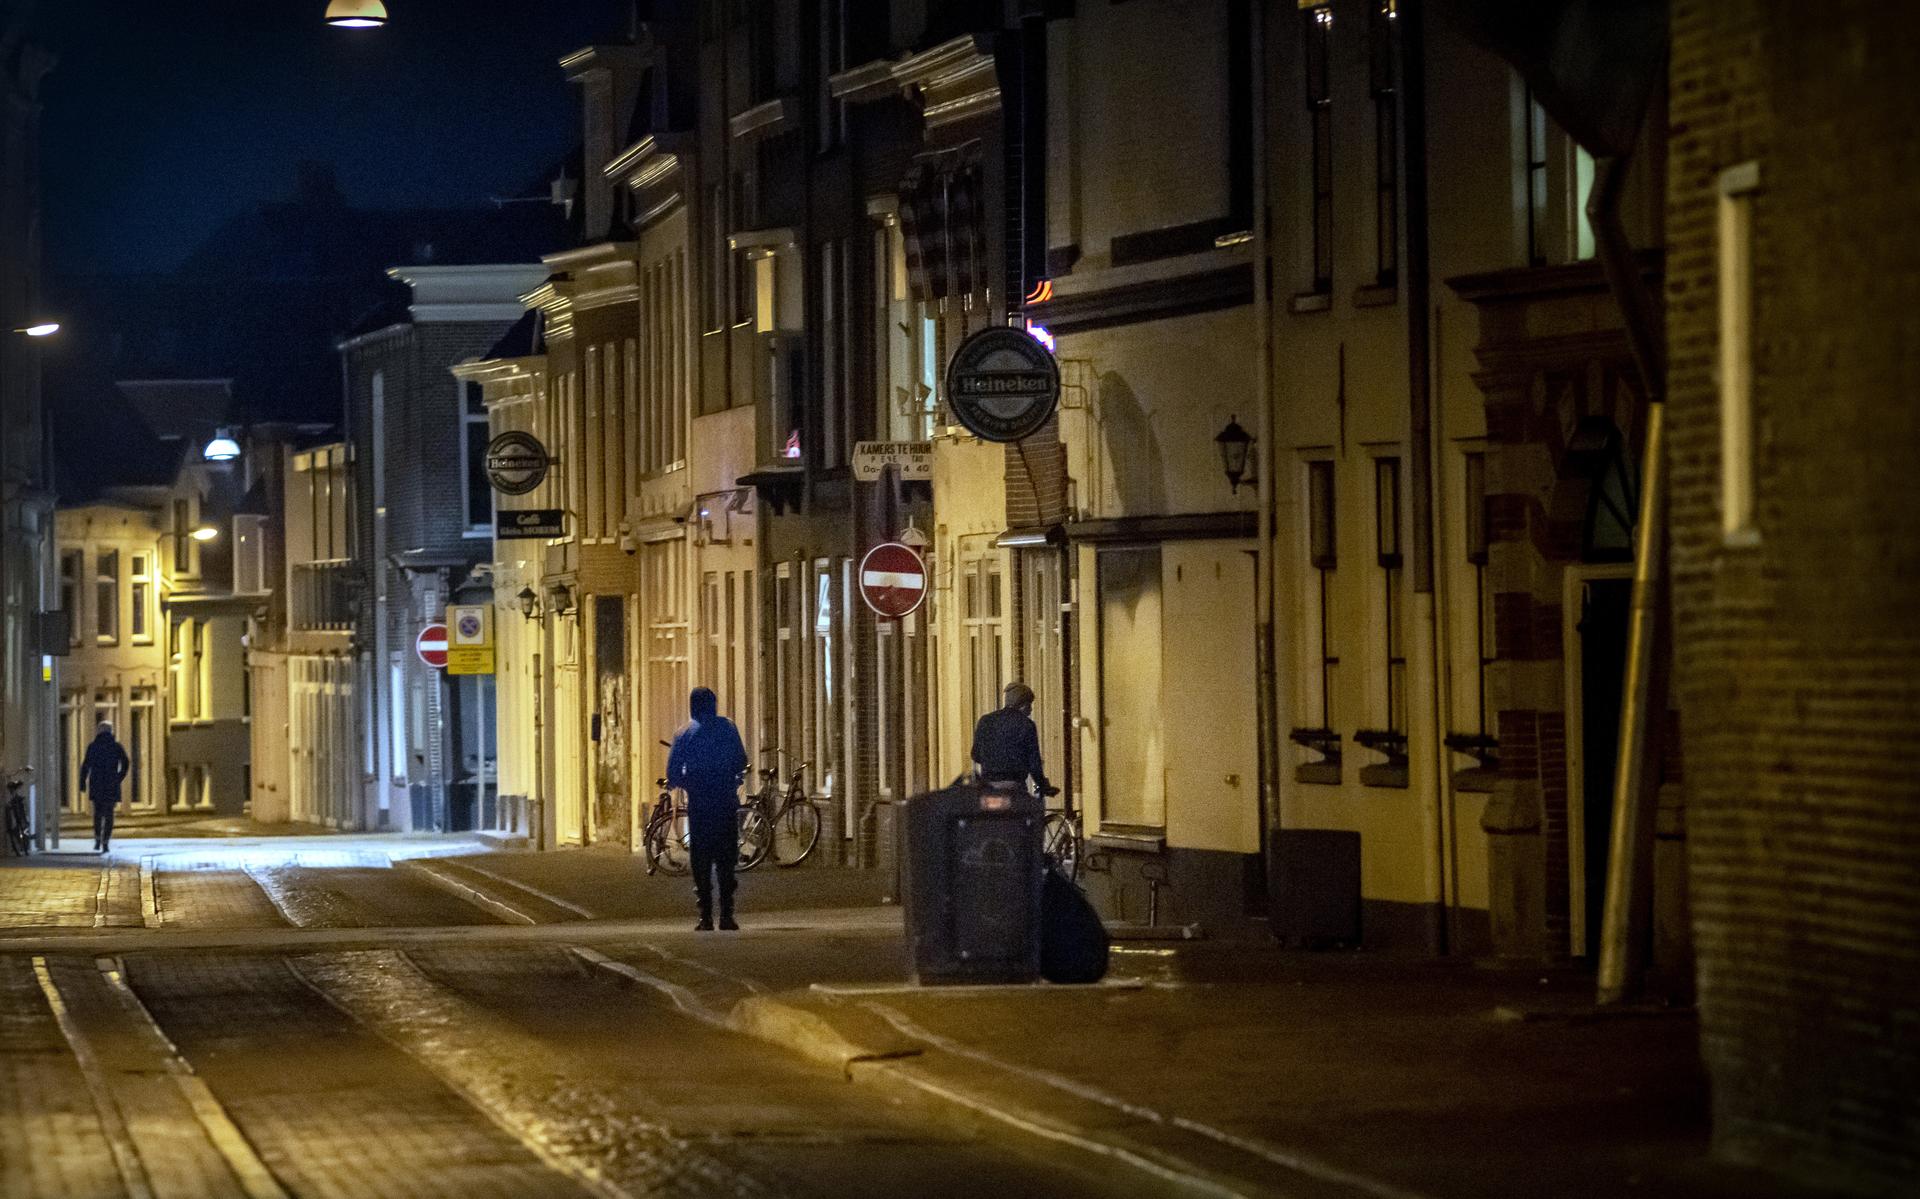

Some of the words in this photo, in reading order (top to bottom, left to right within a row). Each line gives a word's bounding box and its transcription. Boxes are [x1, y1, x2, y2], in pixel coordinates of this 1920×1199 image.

[962, 376, 1048, 393] Heineken
[860, 443, 895, 454] KAMERS
[897, 443, 908, 454] TE
